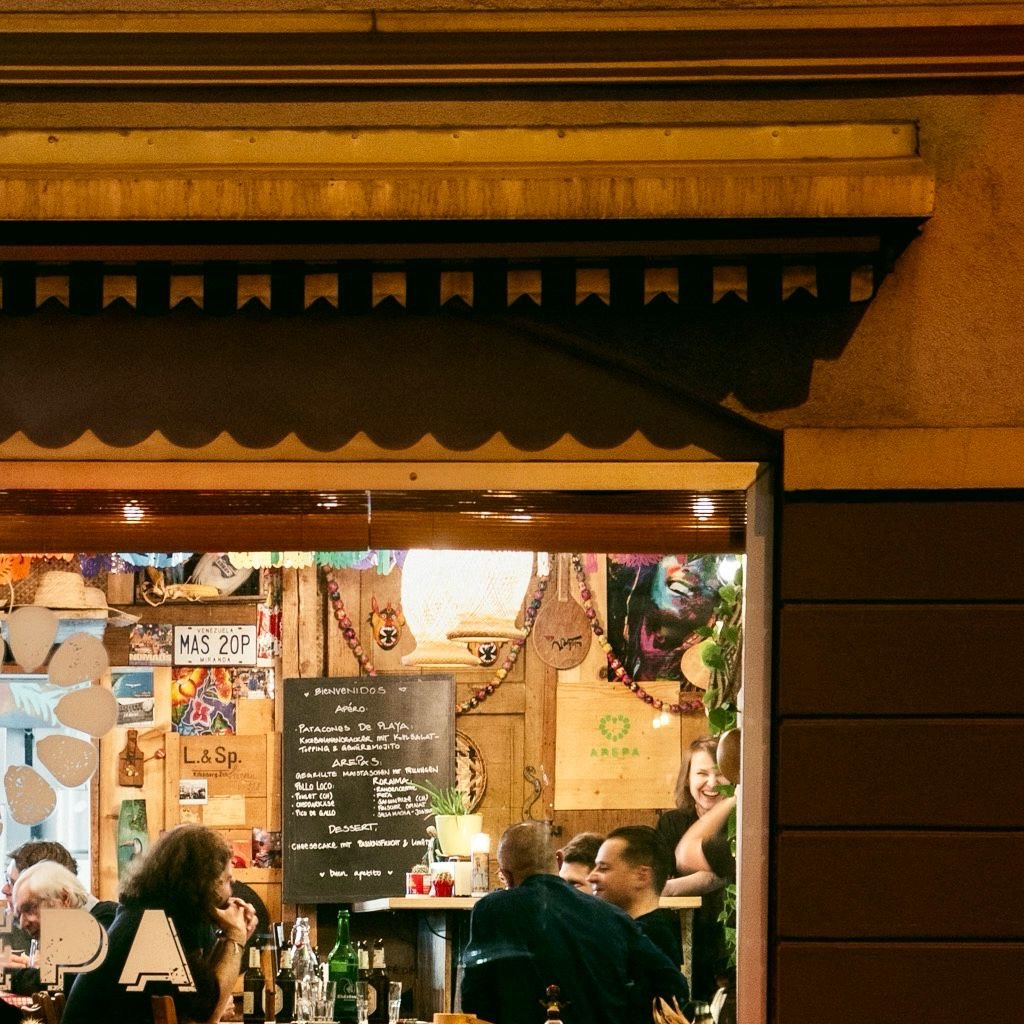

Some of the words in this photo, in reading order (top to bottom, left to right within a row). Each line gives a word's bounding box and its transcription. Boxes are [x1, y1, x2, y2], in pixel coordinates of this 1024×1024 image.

[180, 634, 210, 655] MAS
[219, 634, 251, 655] 20P
[314, 686, 386, 696] BIENVENIDOS
[215, 746, 242, 769] Sp.
[590, 747, 640, 757] AREPA
